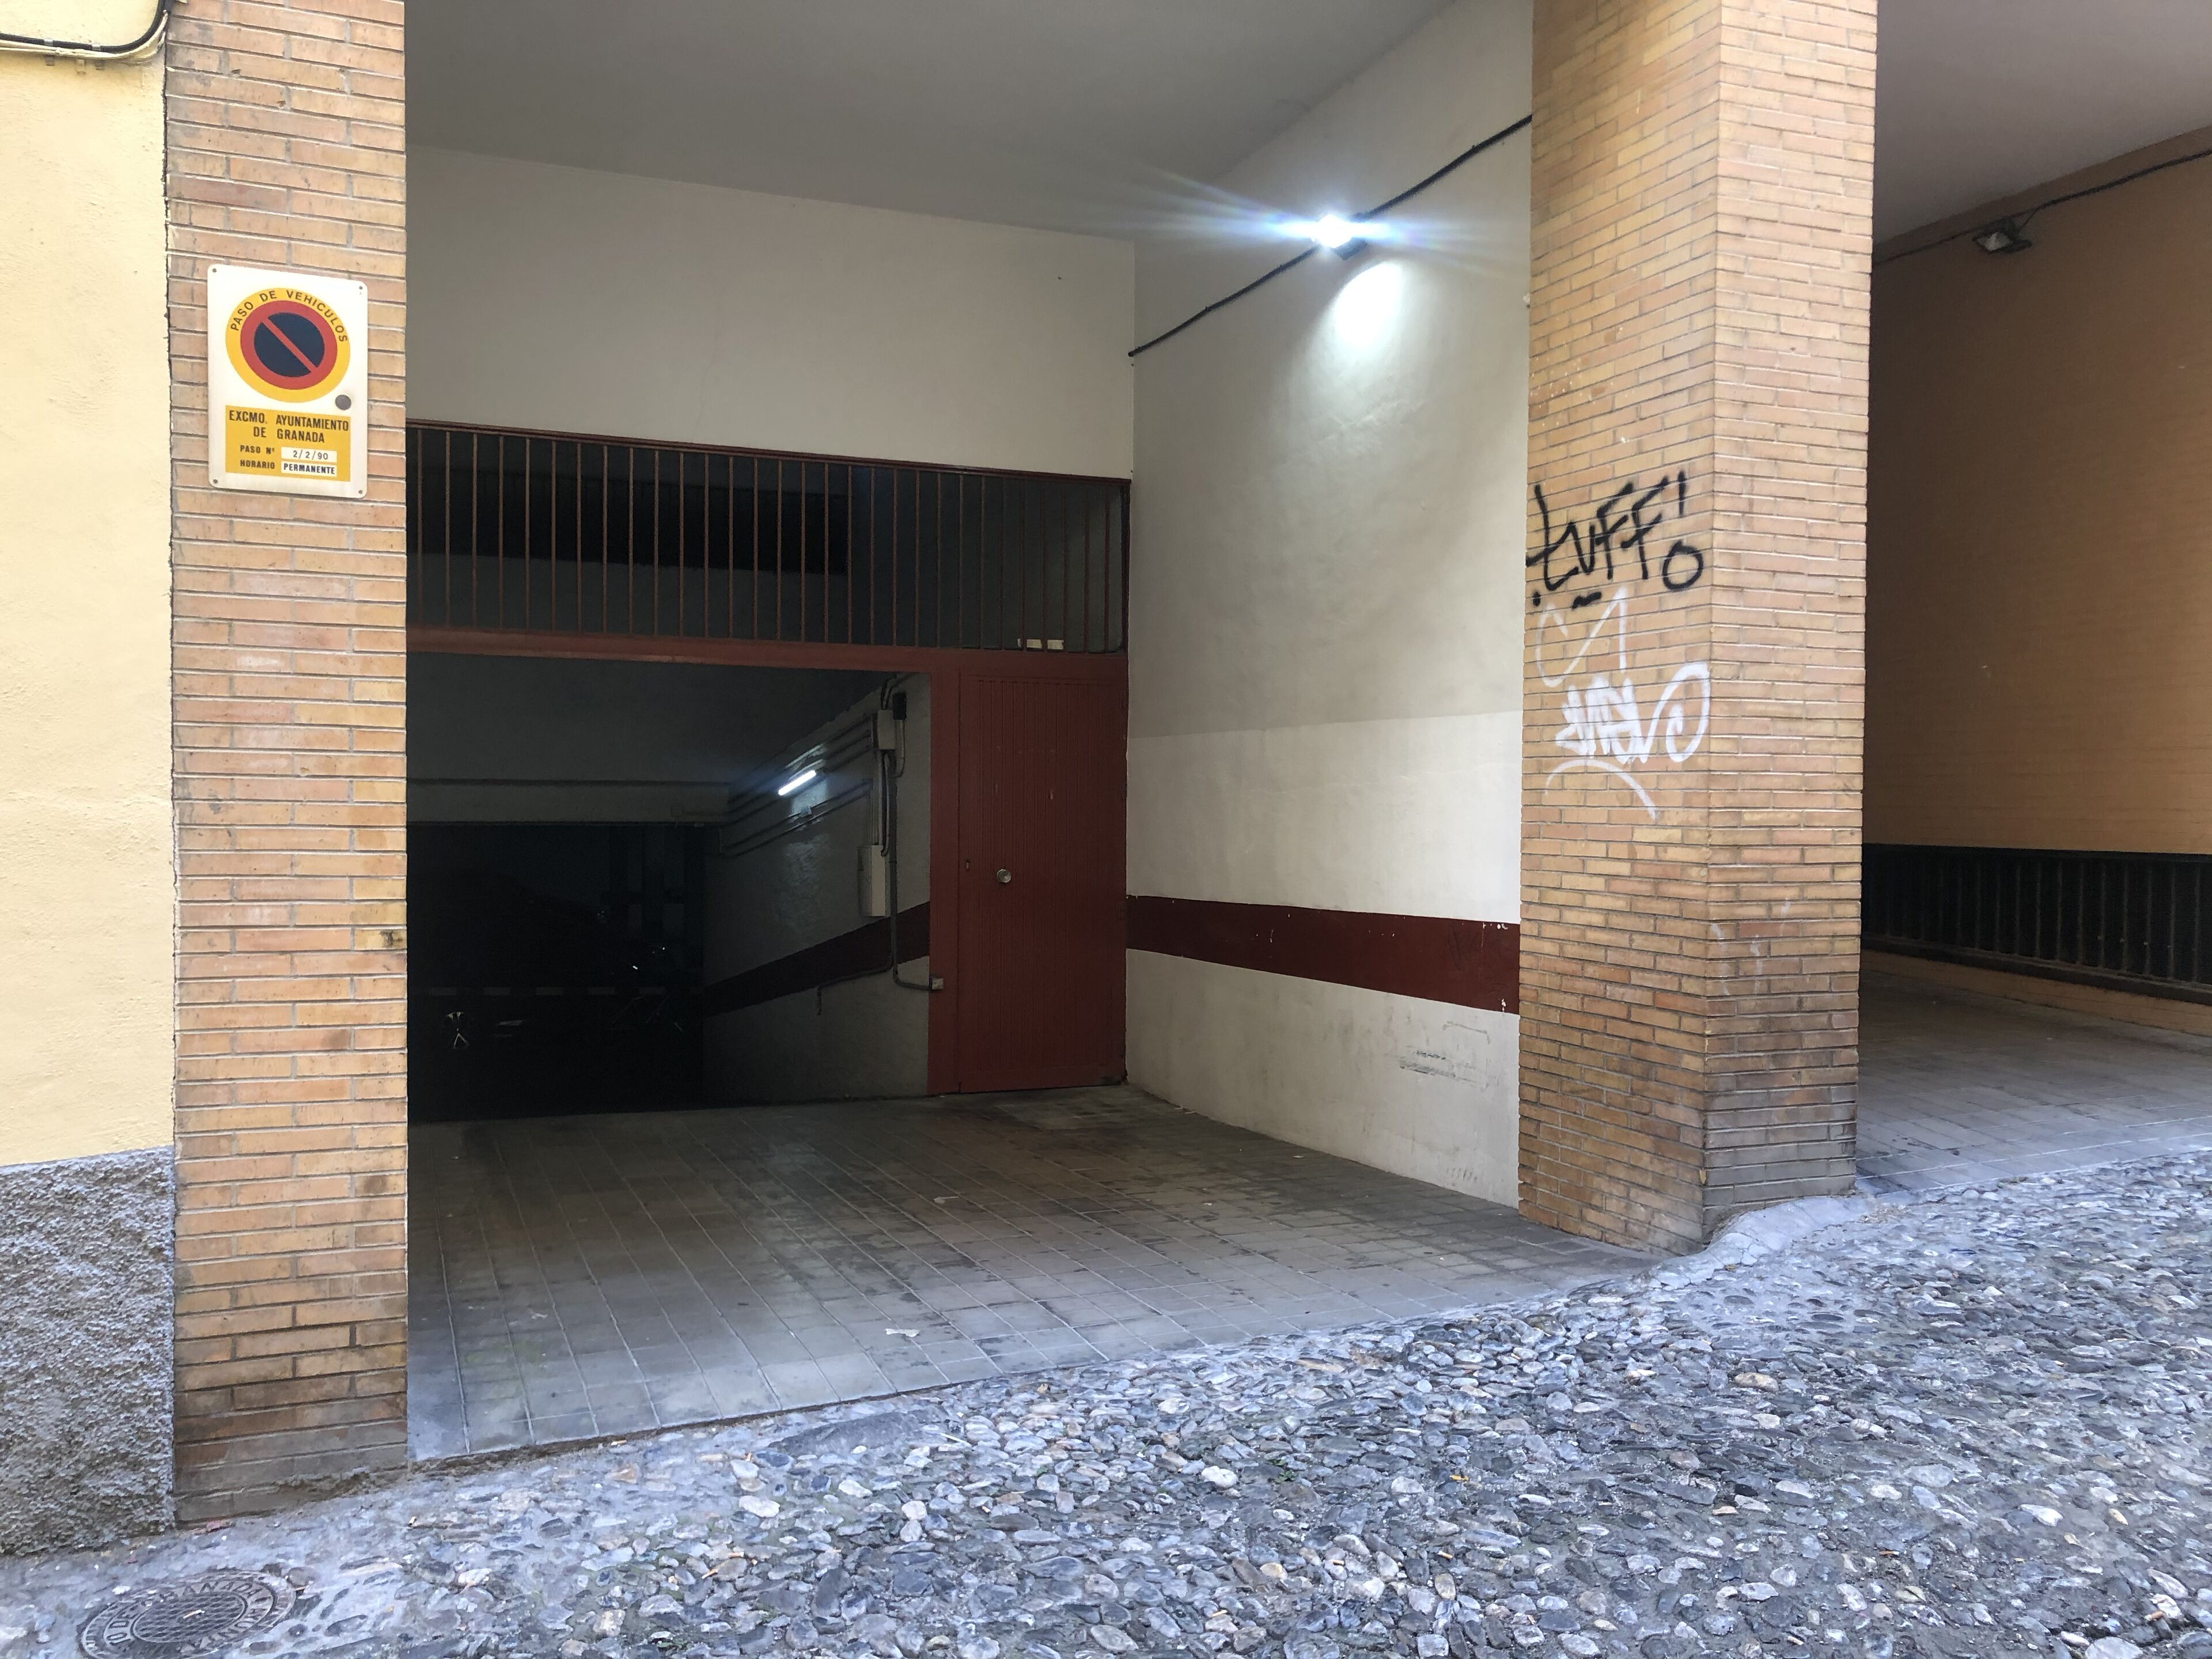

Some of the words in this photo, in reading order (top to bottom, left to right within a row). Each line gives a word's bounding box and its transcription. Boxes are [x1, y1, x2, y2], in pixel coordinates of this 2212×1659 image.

[230, 301, 253, 331] PASO
[259, 290, 277, 302] DE
[286, 290, 348, 342] VEHICULOS
[229, 410, 267, 424] EXCMO.
[276, 414, 349, 431] AYUNTAMIENTO
[253, 426, 267, 438] DE
[277, 429, 325, 443] GRANADA
[240, 445, 261, 453] PASO
[240, 459, 275, 469] HORARIO
[283, 463, 335, 475] PERMANENTE
